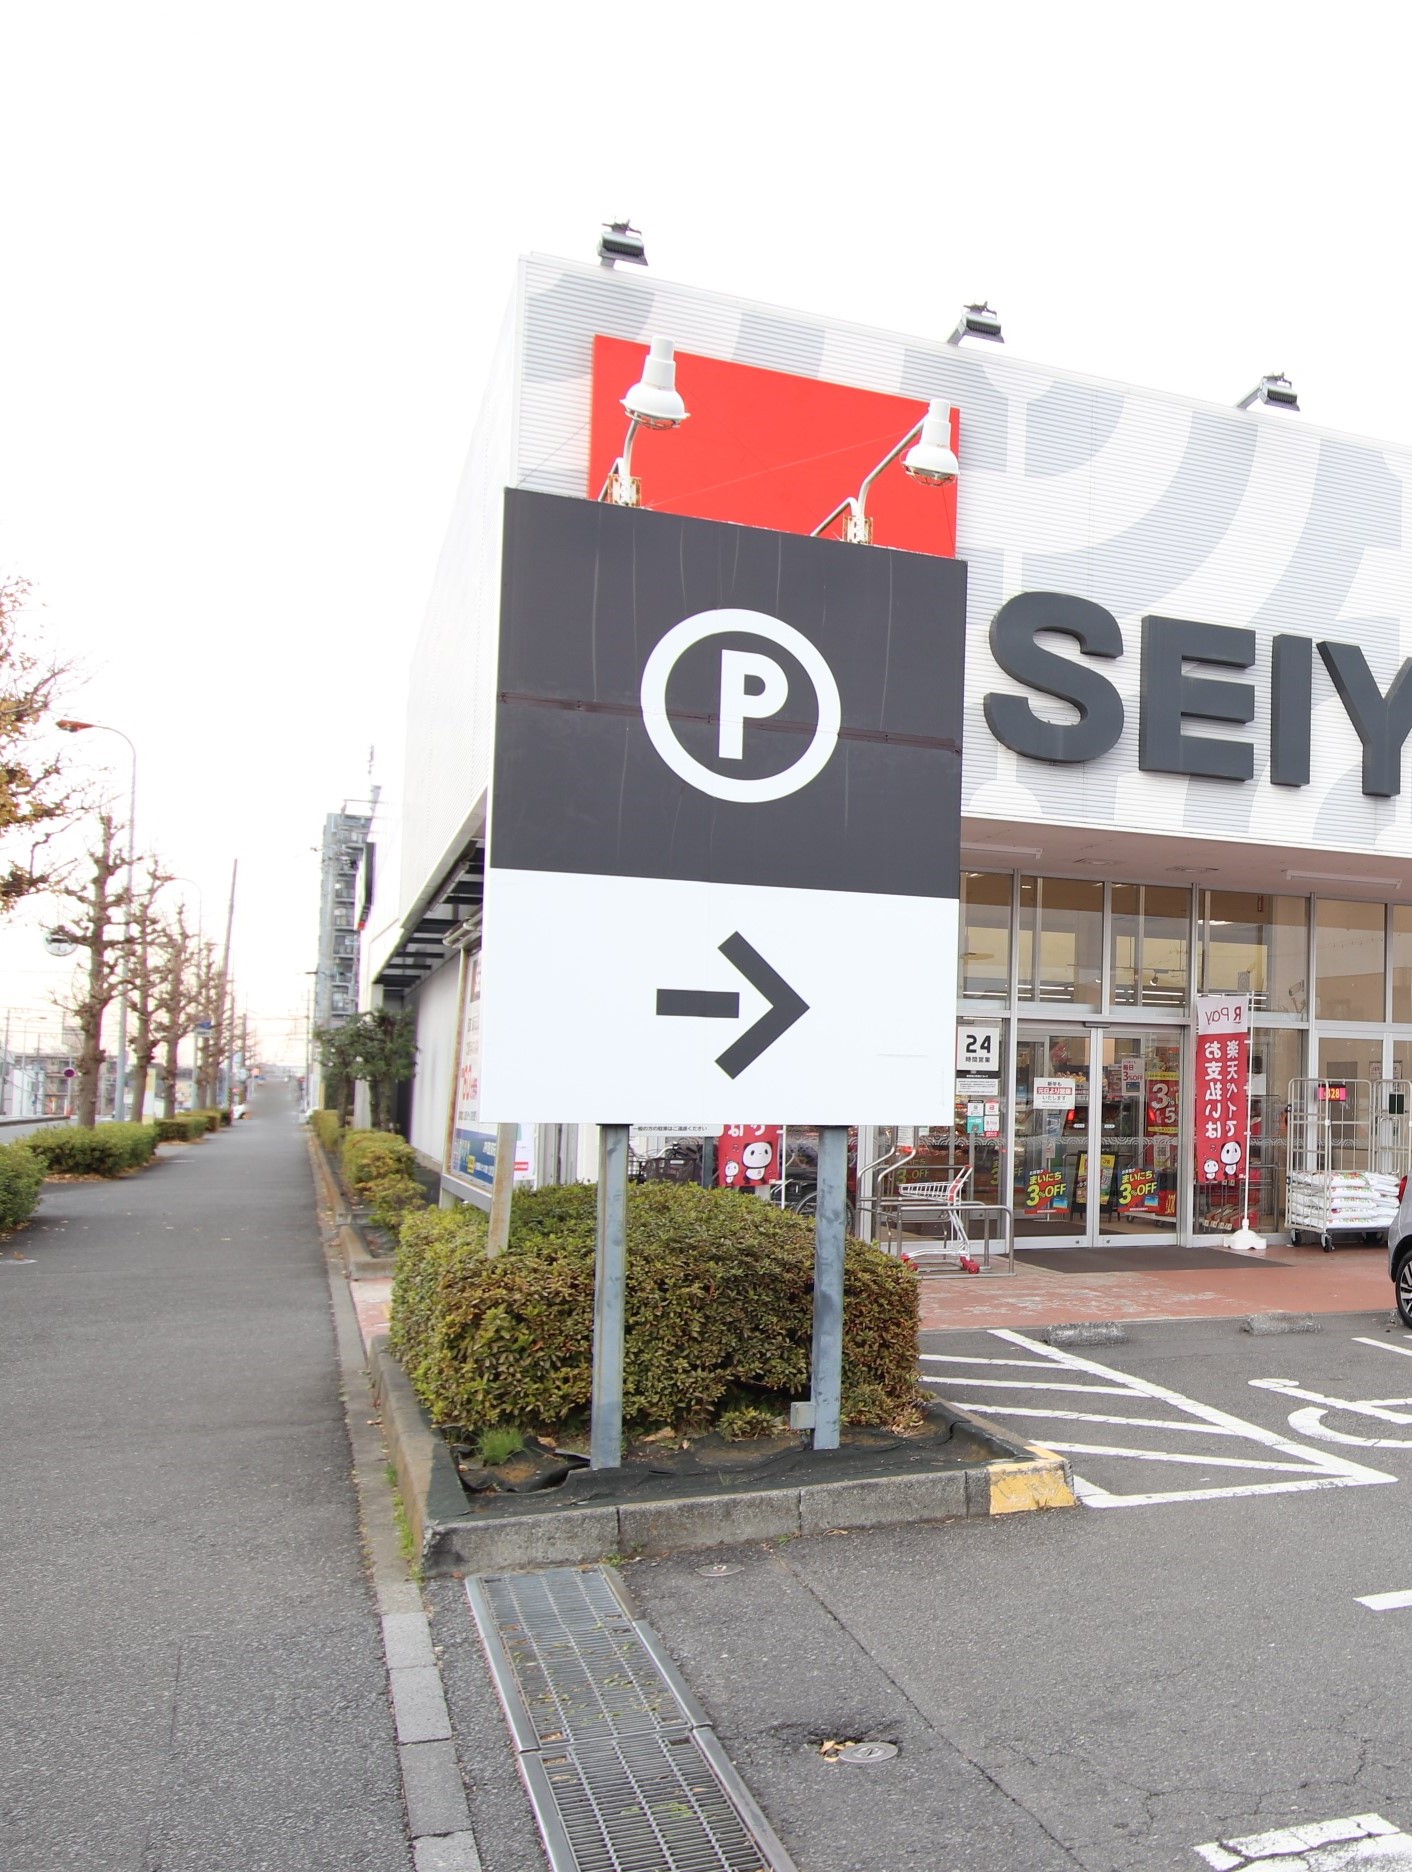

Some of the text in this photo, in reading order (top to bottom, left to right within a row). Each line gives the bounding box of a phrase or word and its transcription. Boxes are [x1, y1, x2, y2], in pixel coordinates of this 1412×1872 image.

[719, 649, 788, 760] P
[966, 1034, 991, 1054] 24
[1029, 1171, 1062, 1185] まいにち
[1121, 1170, 1153, 1184] まいにち
[1026, 1183, 1067, 1206] 3%OFF
[1118, 1181, 1158, 1205] 3%OFF
